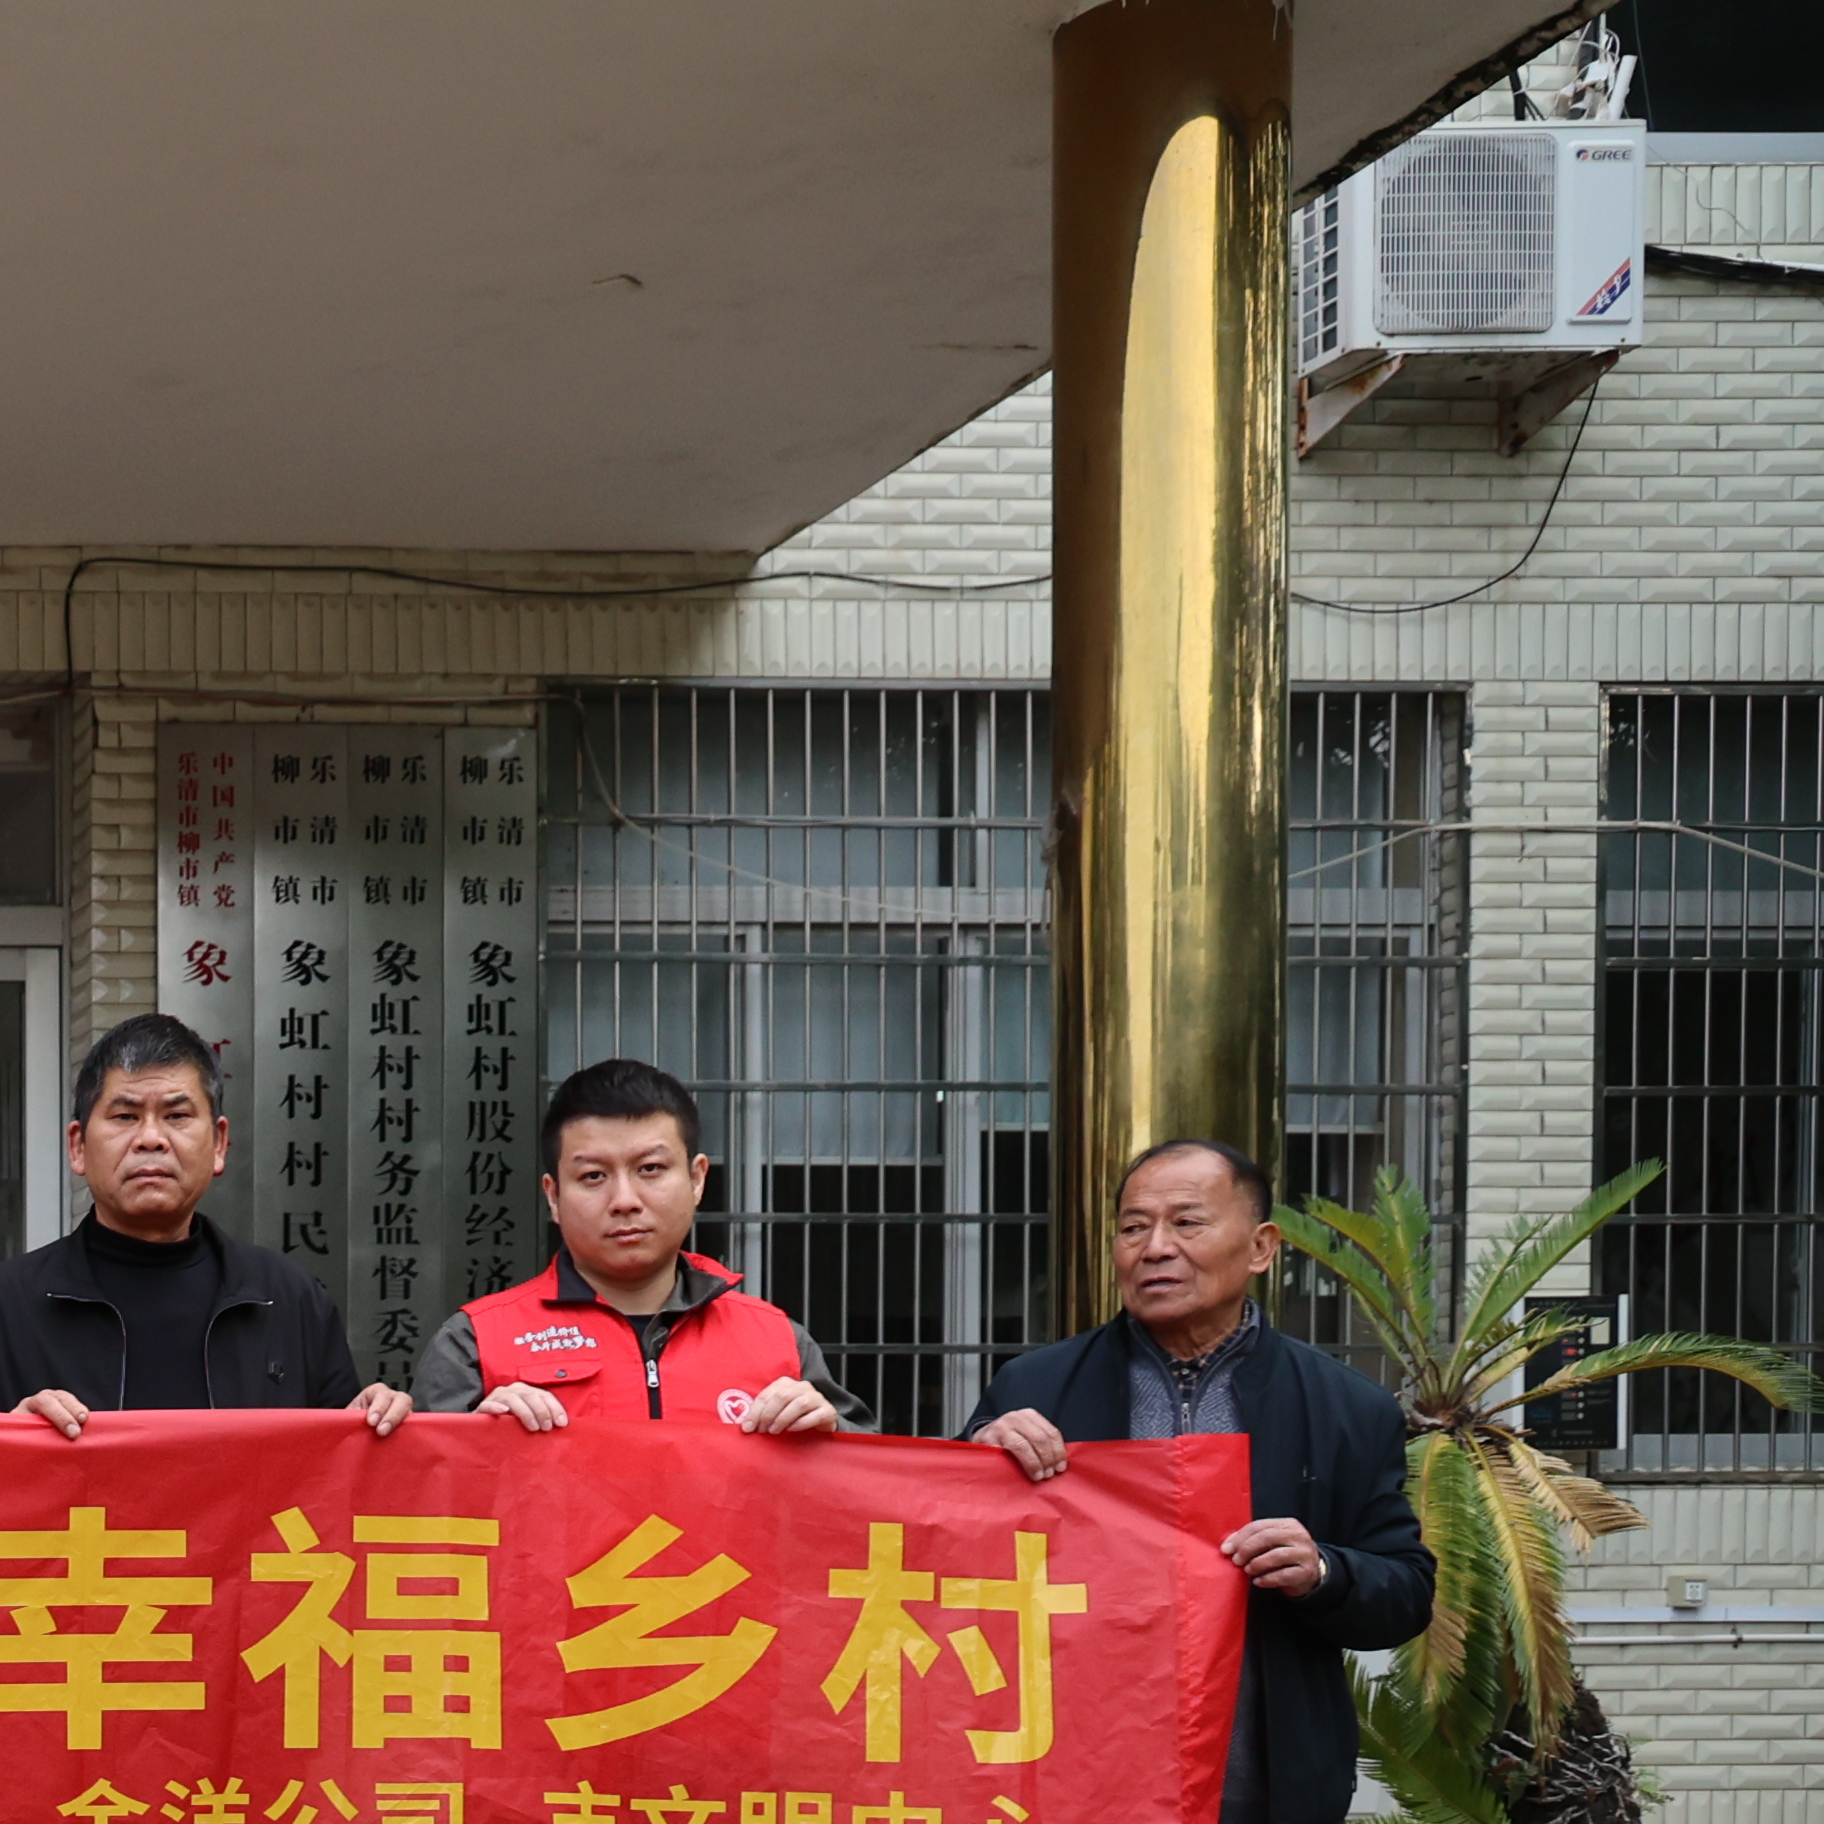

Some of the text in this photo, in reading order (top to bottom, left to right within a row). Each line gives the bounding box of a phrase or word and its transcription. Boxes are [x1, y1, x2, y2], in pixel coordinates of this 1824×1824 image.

[1591, 150, 1631, 160] GREE
[177, 751, 201, 907] 乐清市柳市镇
[213, 751, 235, 908] 中国共产党
[271, 754, 300, 905] 柳市镇
[310, 753, 337, 905] 乐清市
[363, 754, 391, 905] 柳市镇
[401, 754, 428, 906] 乐清市
[460, 754, 489, 905] 柳市镇
[498, 755, 525, 906] 乐清市
[277, 939, 331, 1292] 象虹村村民
